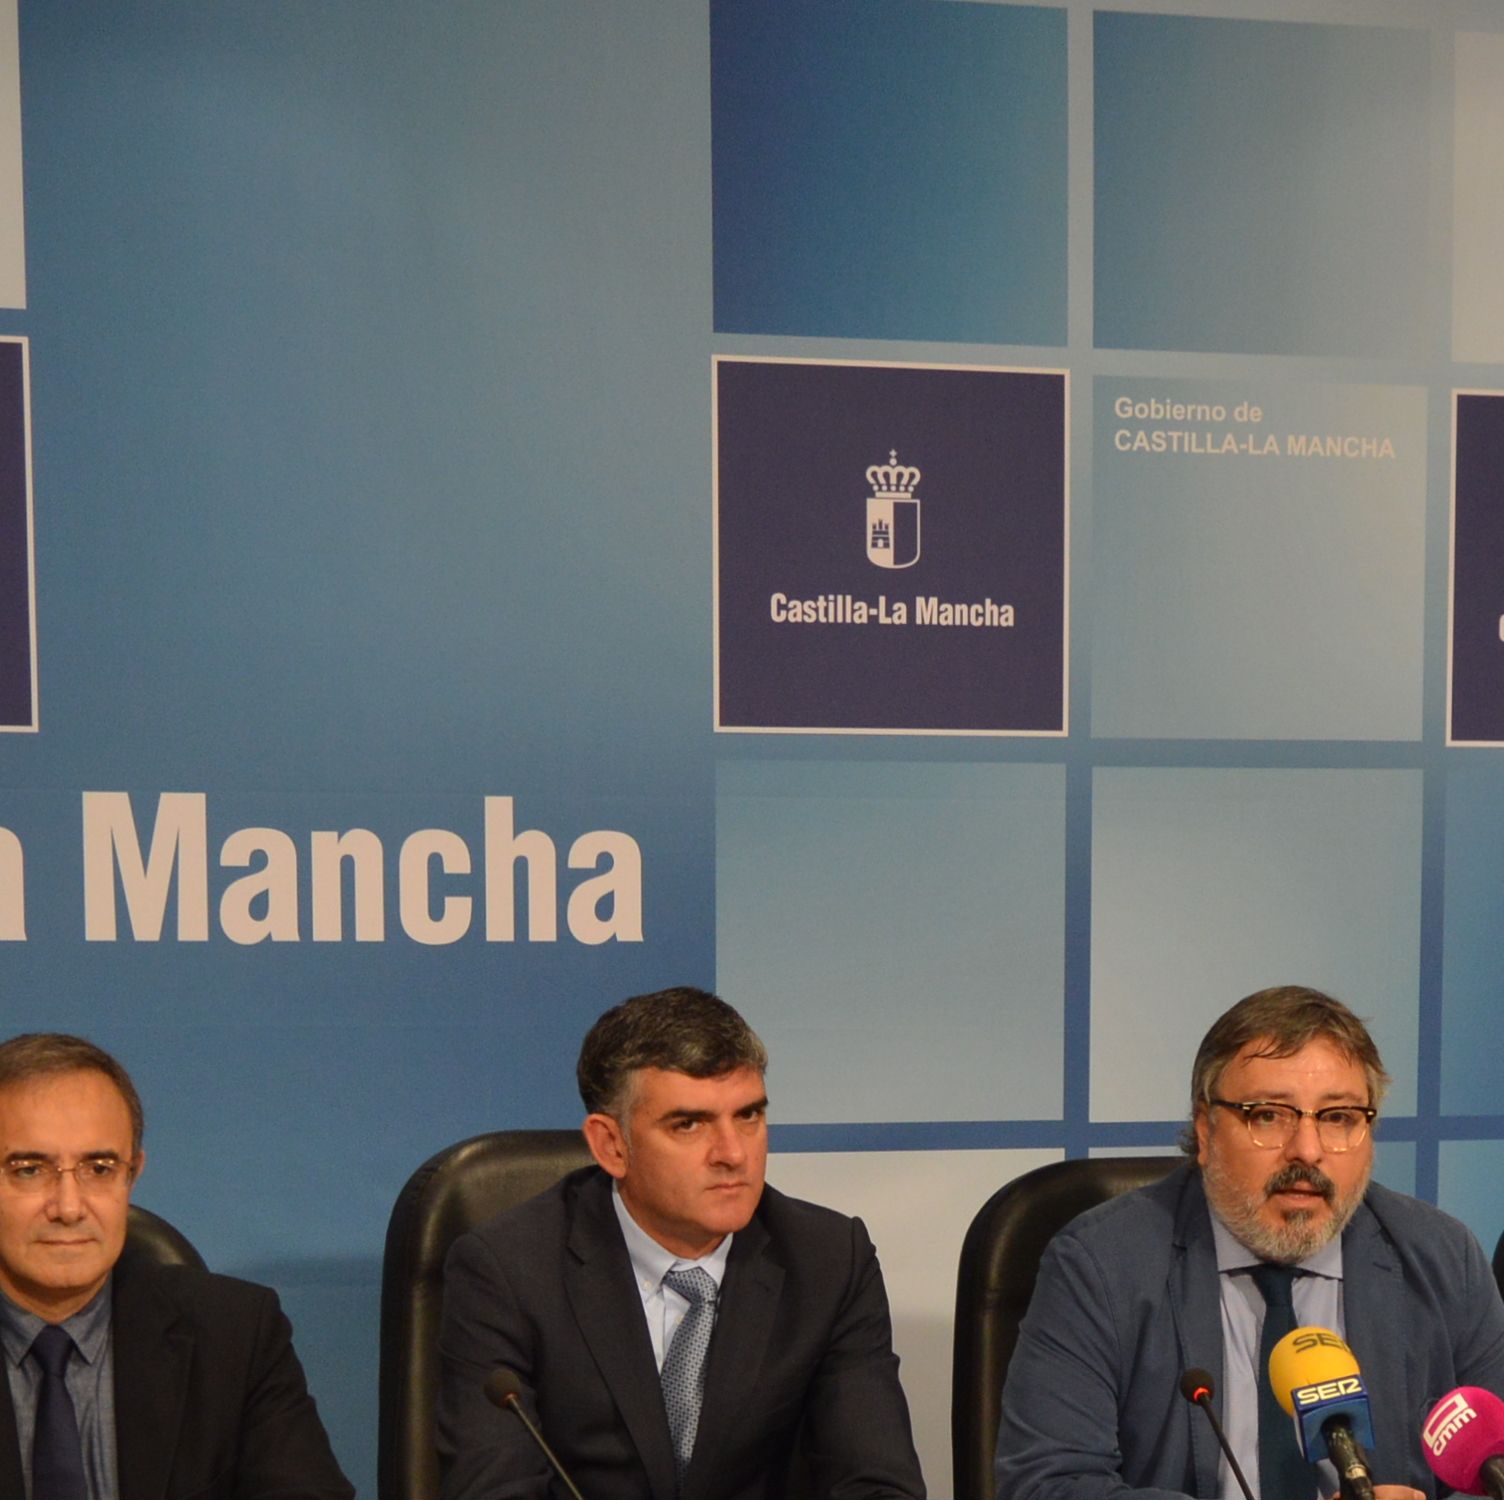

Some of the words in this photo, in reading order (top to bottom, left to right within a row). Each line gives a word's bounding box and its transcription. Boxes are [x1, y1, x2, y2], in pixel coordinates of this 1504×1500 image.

[1114, 396, 1226, 422] Gobierno
[1233, 401, 1263, 422] de
[1114, 429, 1280, 456] CASTILLA-LA
[1286, 434, 1395, 459] MANCHA
[770, 592, 908, 625] Castilla-La
[915, 596, 1015, 627] Mancha
[81, 790, 645, 946] Mancha
[1292, 1332, 1351, 1355] SE
[1297, 1377, 1363, 1405] SER
